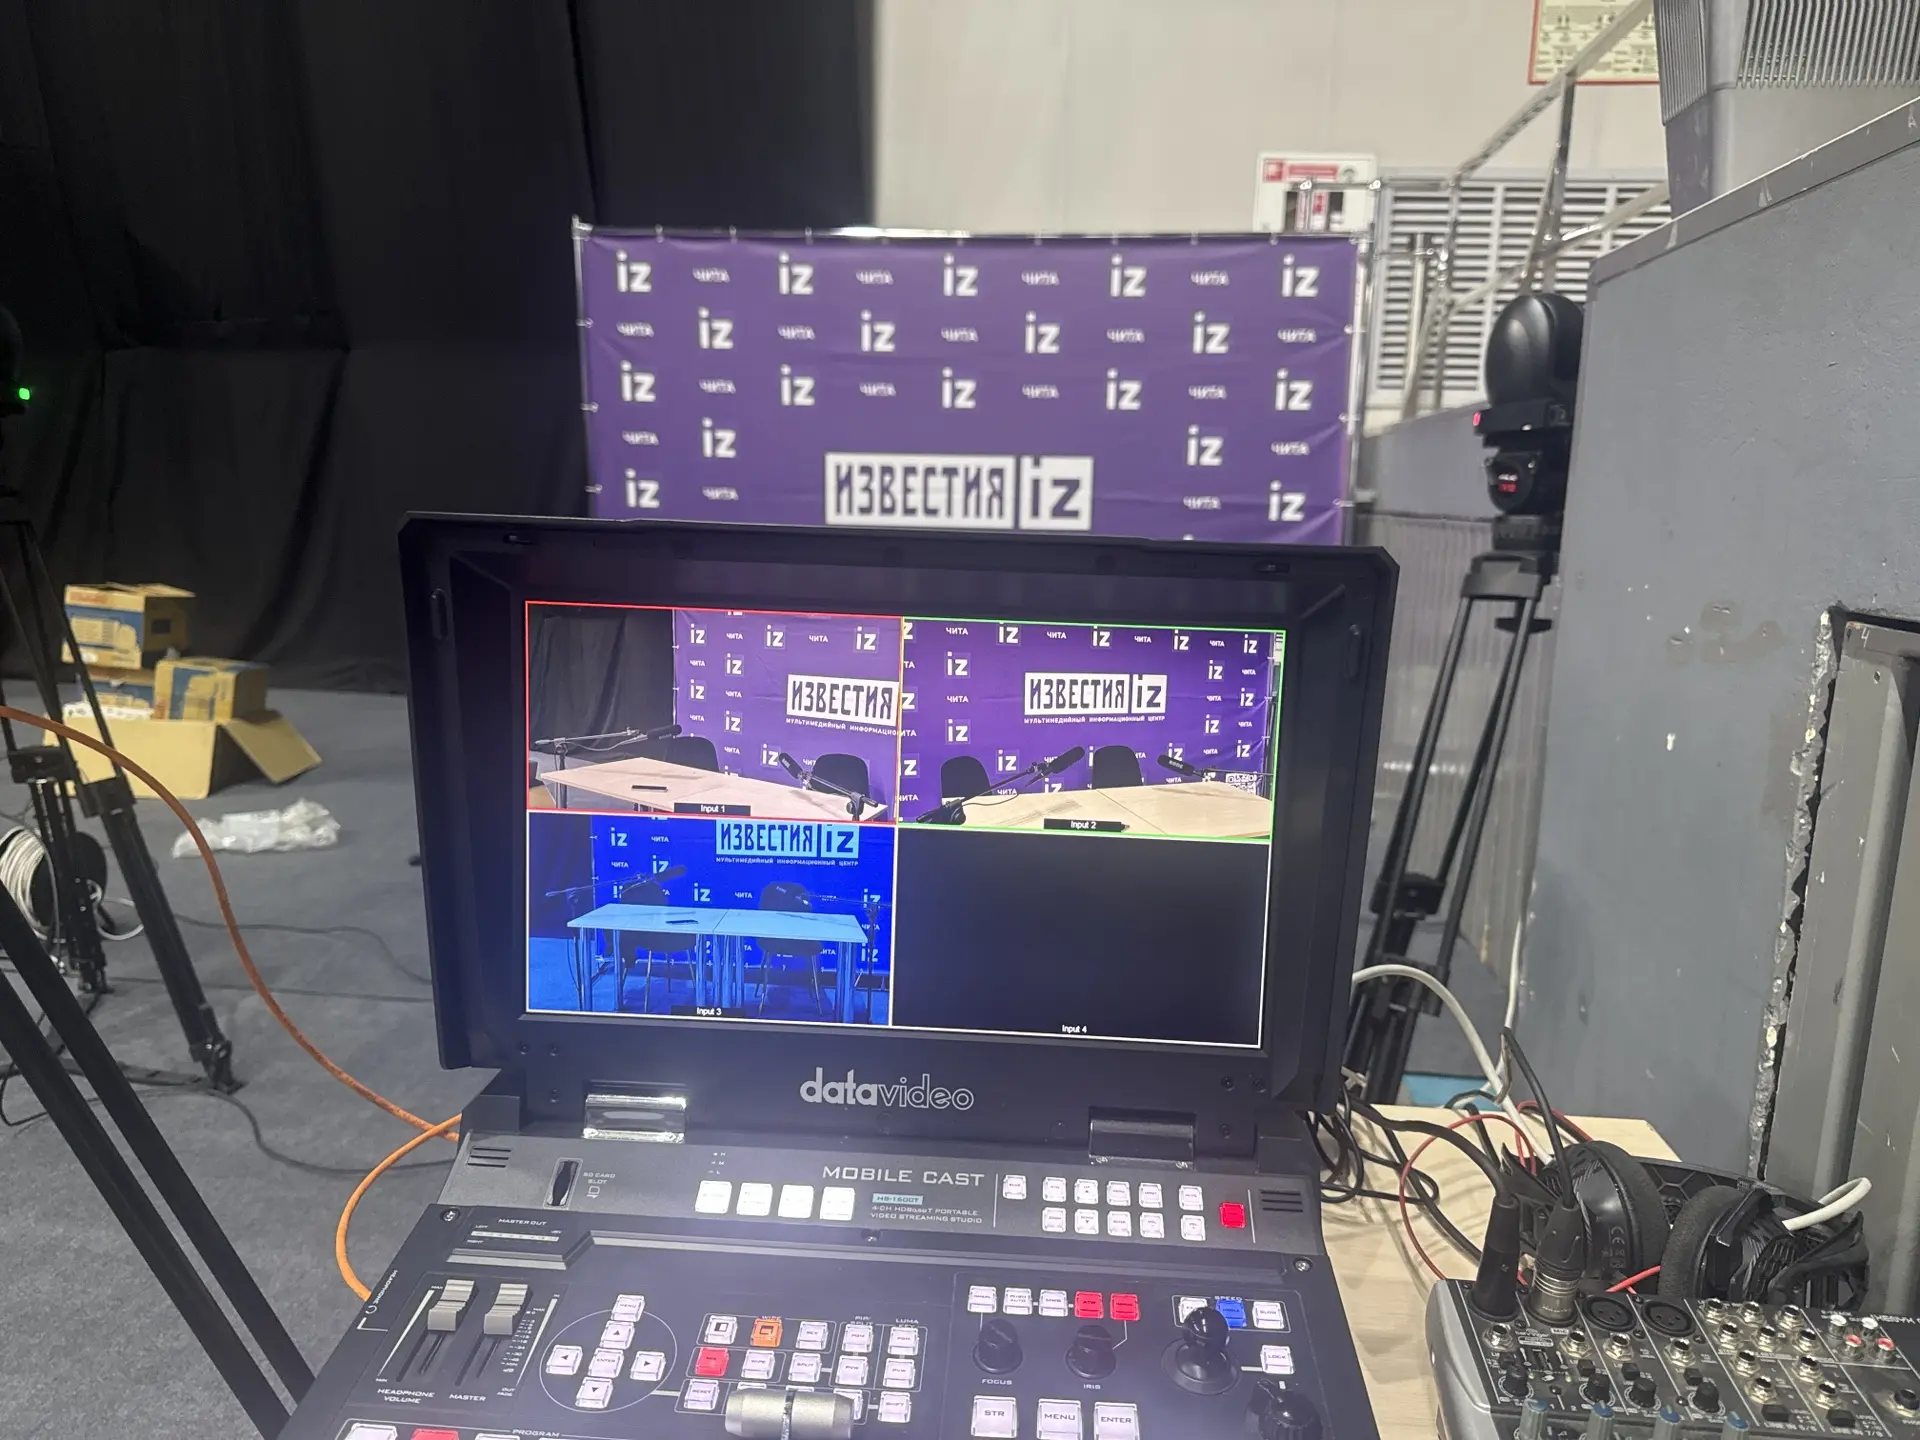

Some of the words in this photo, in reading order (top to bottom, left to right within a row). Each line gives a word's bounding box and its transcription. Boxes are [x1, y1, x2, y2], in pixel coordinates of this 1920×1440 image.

[616, 250, 652, 292] iz
[779, 251, 814, 295] iz
[943, 252, 978, 297] iz
[1110, 254, 1146, 297] iz
[1282, 254, 1319, 297] iz
[699, 307, 733, 349] iz
[860, 310, 895, 352] iz
[1025, 311, 1060, 354] iz
[1193, 311, 1229, 354] iz
[621, 361, 656, 402] iz
[780, 364, 815, 406] iz
[942, 367, 976, 409] iz
[1106, 368, 1141, 410] iz
[1275, 368, 1312, 411] iz
[702, 417, 736, 458] iz
[1187, 425, 1223, 466] iz
[626, 468, 659, 508] iz
[836, 464, 1003, 517] ИЗВЕСТИЯ
[1268, 480, 1305, 521] iz
[691, 623, 705, 644] iz
[726, 632, 743, 640] ЧИТА
[766, 624, 783, 647] iz
[856, 626, 876, 650] iz
[999, 621, 1018, 643] iz
[1092, 626, 1110, 647] iz
[1174, 630, 1189, 650] iz
[1244, 634, 1257, 653] iz
[726, 653, 742, 675] iz
[947, 651, 968, 675] iz
[1208, 660, 1223, 679] iz
[690, 679, 704, 699] iz
[725, 690, 742, 698] ЧИТА
[791, 680, 893, 720] ИЗВЕСТИЯ
[1030, 679, 1124, 709] ИЗВЕСТИЯ
[1137, 675, 1161, 708] iz
[1240, 688, 1254, 706] iz
[726, 711, 741, 732] iz
[948, 719, 968, 742] iz
[1205, 714, 1219, 733] iz
[762, 744, 778, 765] iz
[998, 750, 1016, 771] iz
[1237, 740, 1250, 758] iz
[701, 805, 718, 813] Input
[611, 827, 627, 846] iz
[1071, 821, 1089, 829] Input
[721, 824, 812, 852] ИЗВЕСТИЯ
[694, 883, 710, 902] iz
[697, 1008, 713, 1016] Input
[714, 1008, 722, 1016] 3
[1062, 1025, 1079, 1033] Input
[800, 1067, 974, 1110] datavideo
[823, 1166, 912, 1183] MOBILE
[922, 1171, 985, 1186] CAST
[899, 1214, 948, 1222] STREAMING
[377, 1389, 435, 1397] HEADPHONE
[512, 1429, 560, 1437] PROGRAM
